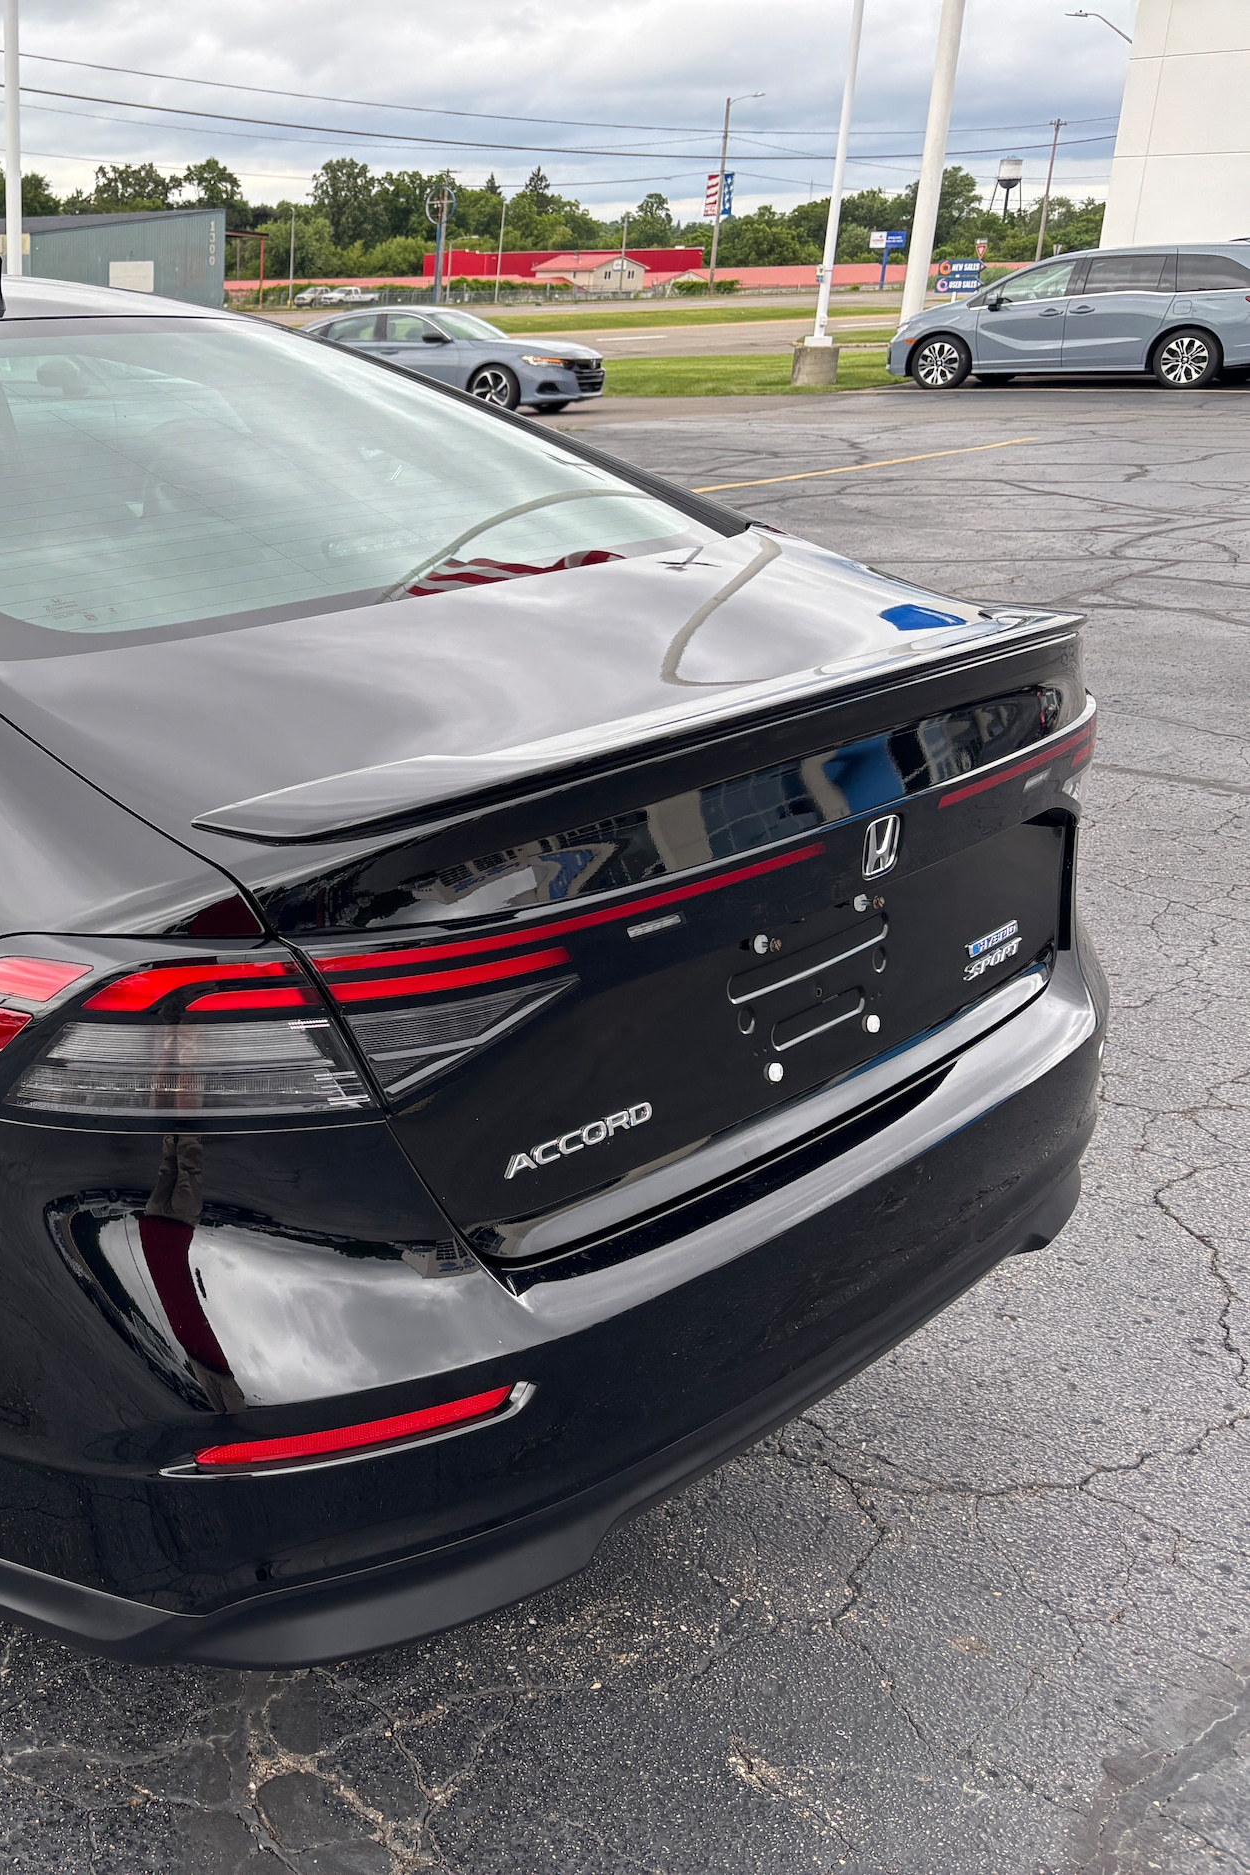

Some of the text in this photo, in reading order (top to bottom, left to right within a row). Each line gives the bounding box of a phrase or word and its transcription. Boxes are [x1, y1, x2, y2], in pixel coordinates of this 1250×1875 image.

[951, 263, 964, 272] NEW
[963, 263, 981, 272] SALES
[948, 280, 963, 289] USED
[961, 280, 978, 289] SALES
[978, 924, 1017, 954] HYBRID
[963, 937, 1022, 981] SPORT
[504, 1101, 653, 1180] ACCORD
